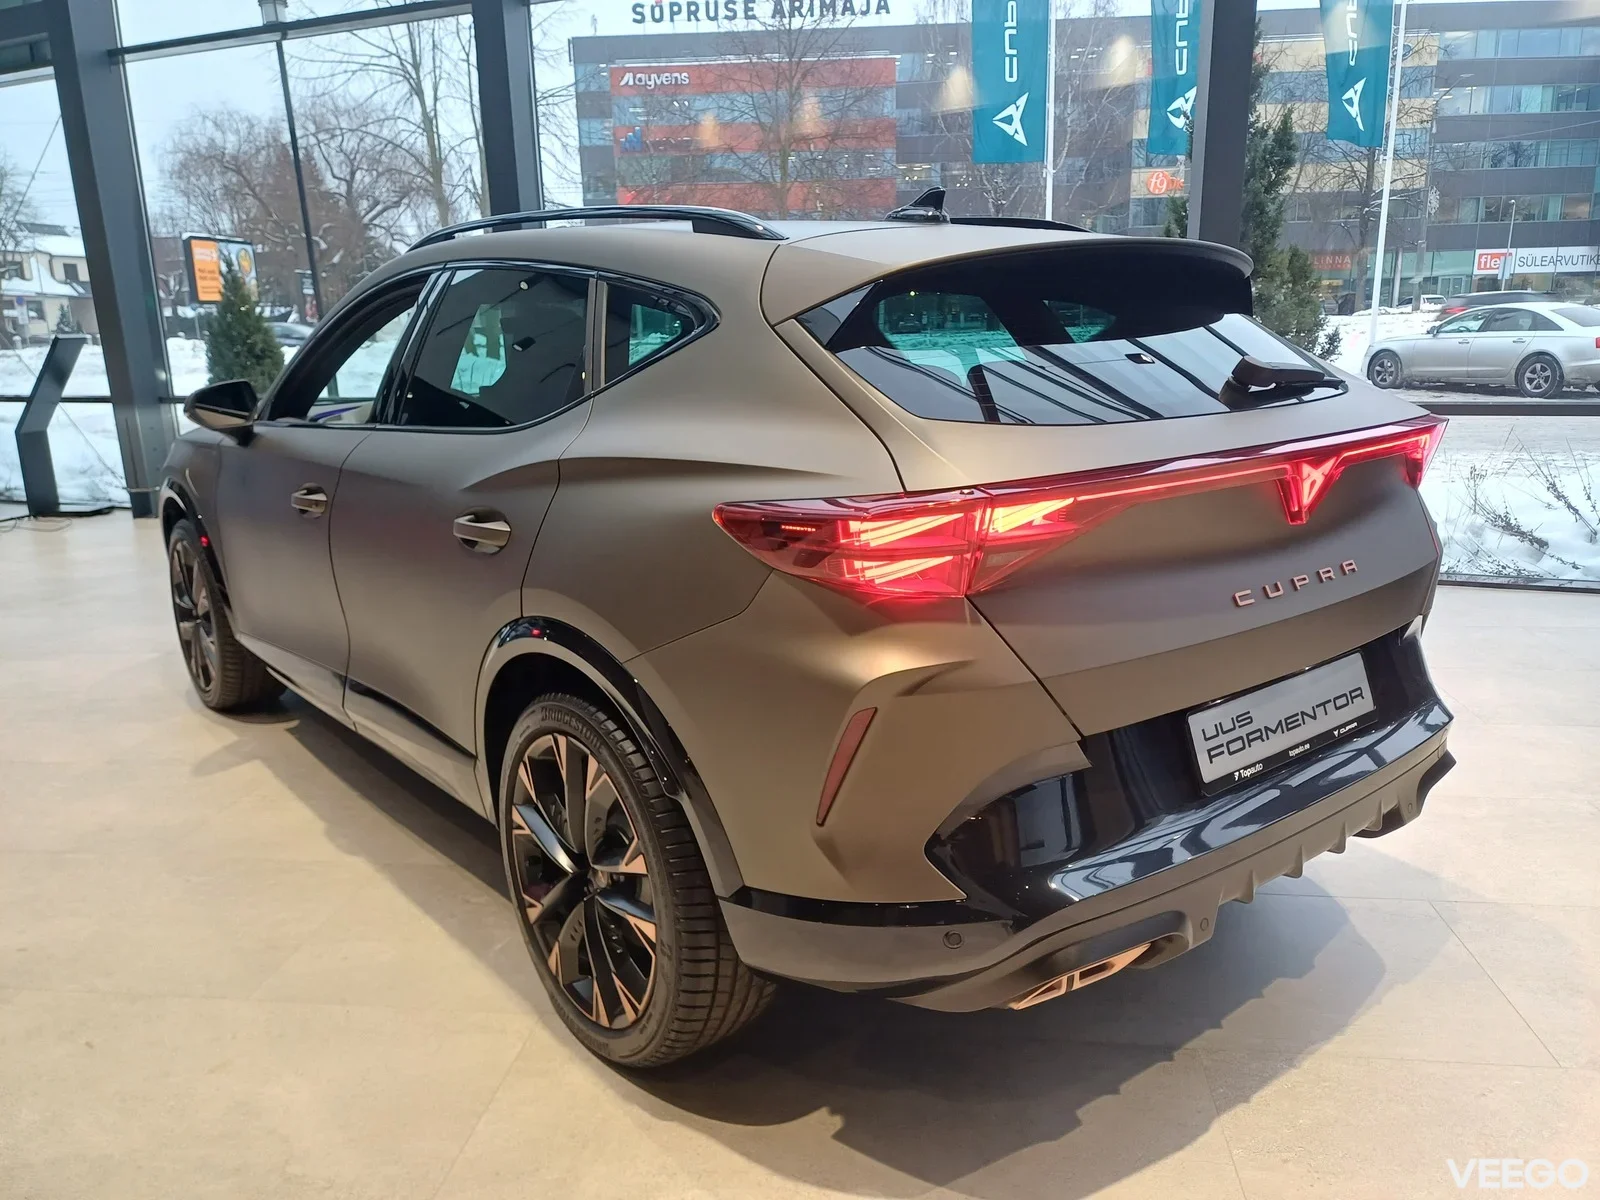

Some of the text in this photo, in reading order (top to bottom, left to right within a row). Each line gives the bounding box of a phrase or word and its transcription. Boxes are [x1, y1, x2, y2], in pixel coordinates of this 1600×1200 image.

[634, 72, 690, 90] ayvens
[1479, 254, 1506, 269] fle
[1232, 559, 1358, 607] CUPRA
[1201, 710, 1254, 742] UUS
[1207, 686, 1365, 765] FORMENTOR
[1240, 763, 1264, 779] Topauto
